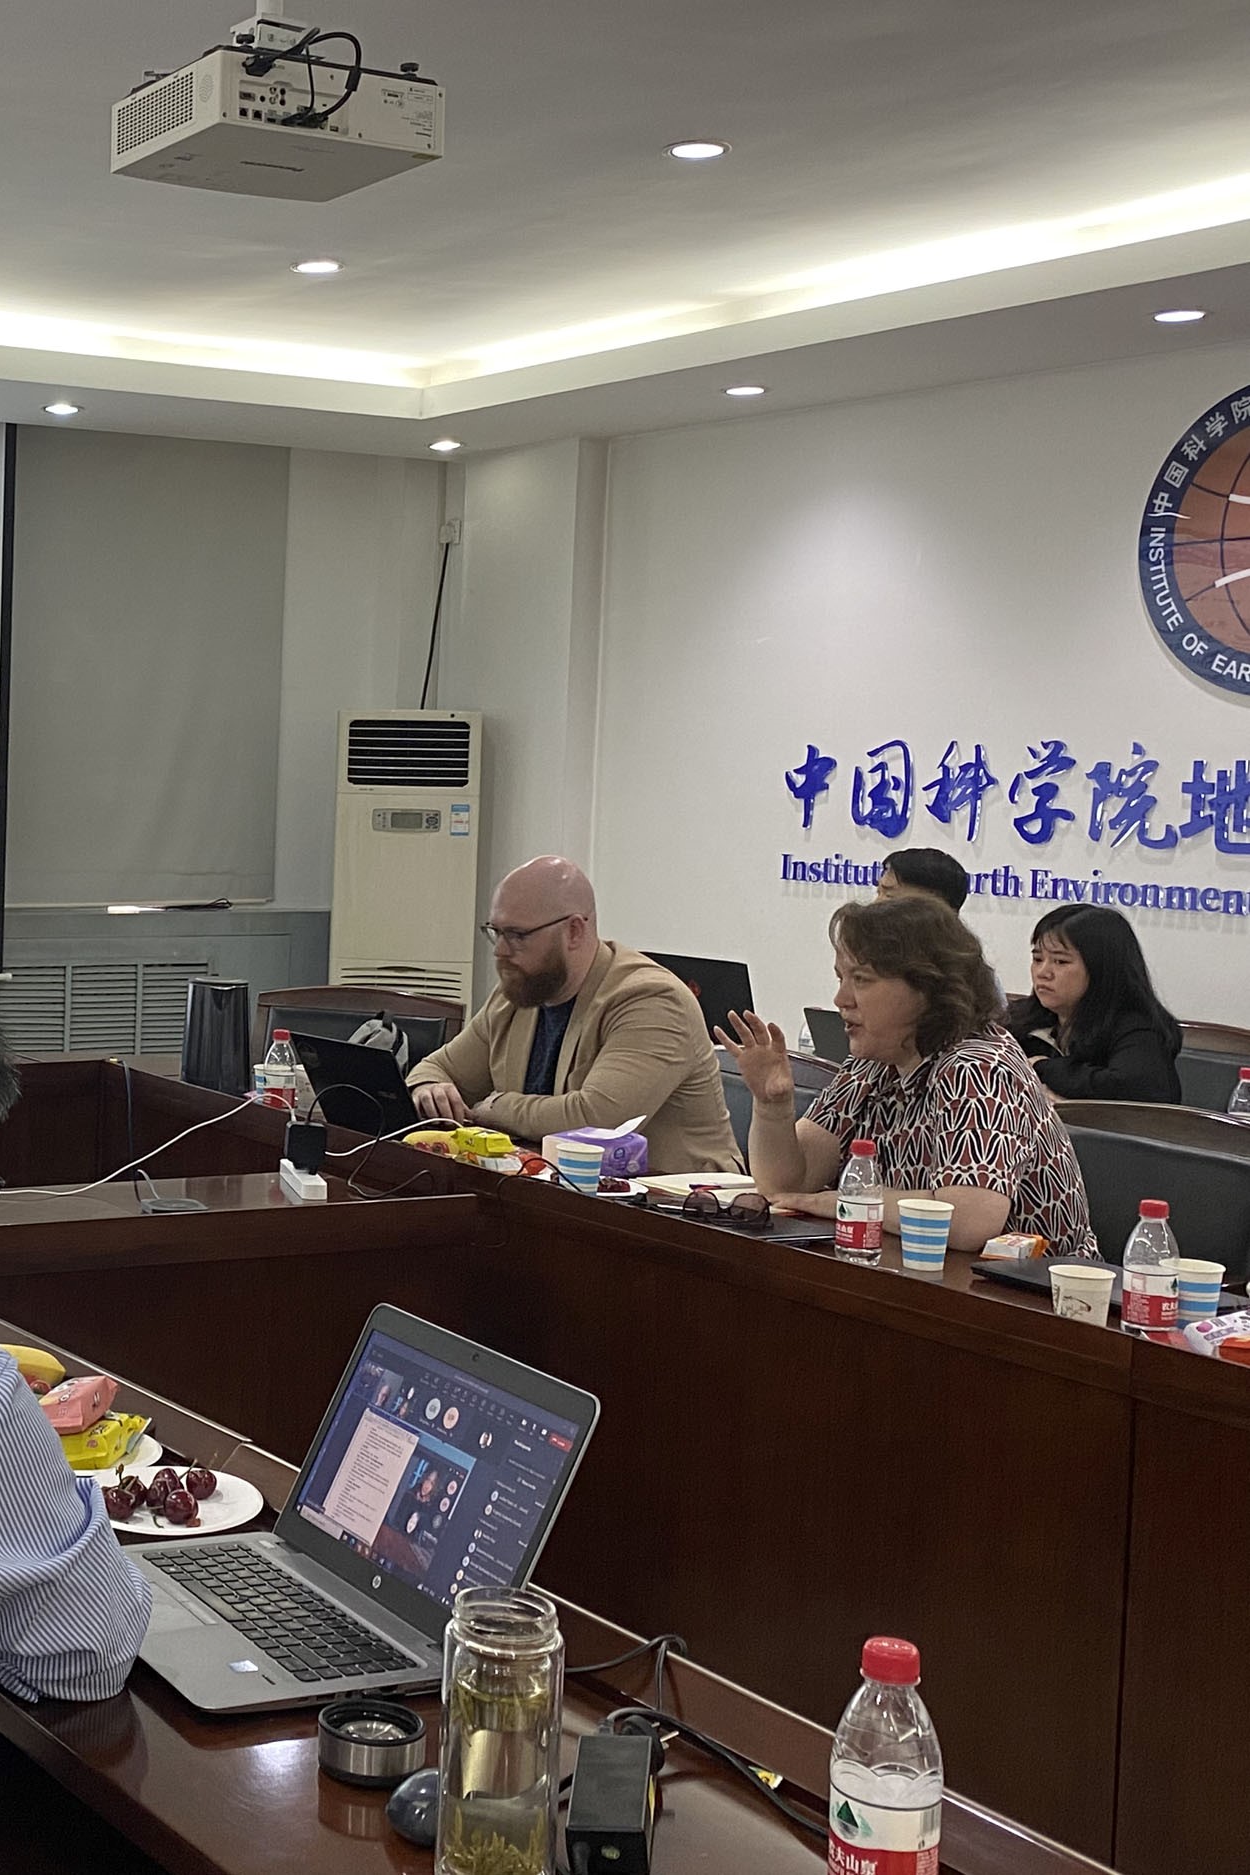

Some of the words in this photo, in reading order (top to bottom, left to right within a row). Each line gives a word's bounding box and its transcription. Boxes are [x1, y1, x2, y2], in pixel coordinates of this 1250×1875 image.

[1148, 527, 1184, 632] INSTITUTE
[1182, 633, 1209, 657] OF
[781, 853, 881, 887] Institut
[1030, 868, 1250, 917] Environmen
